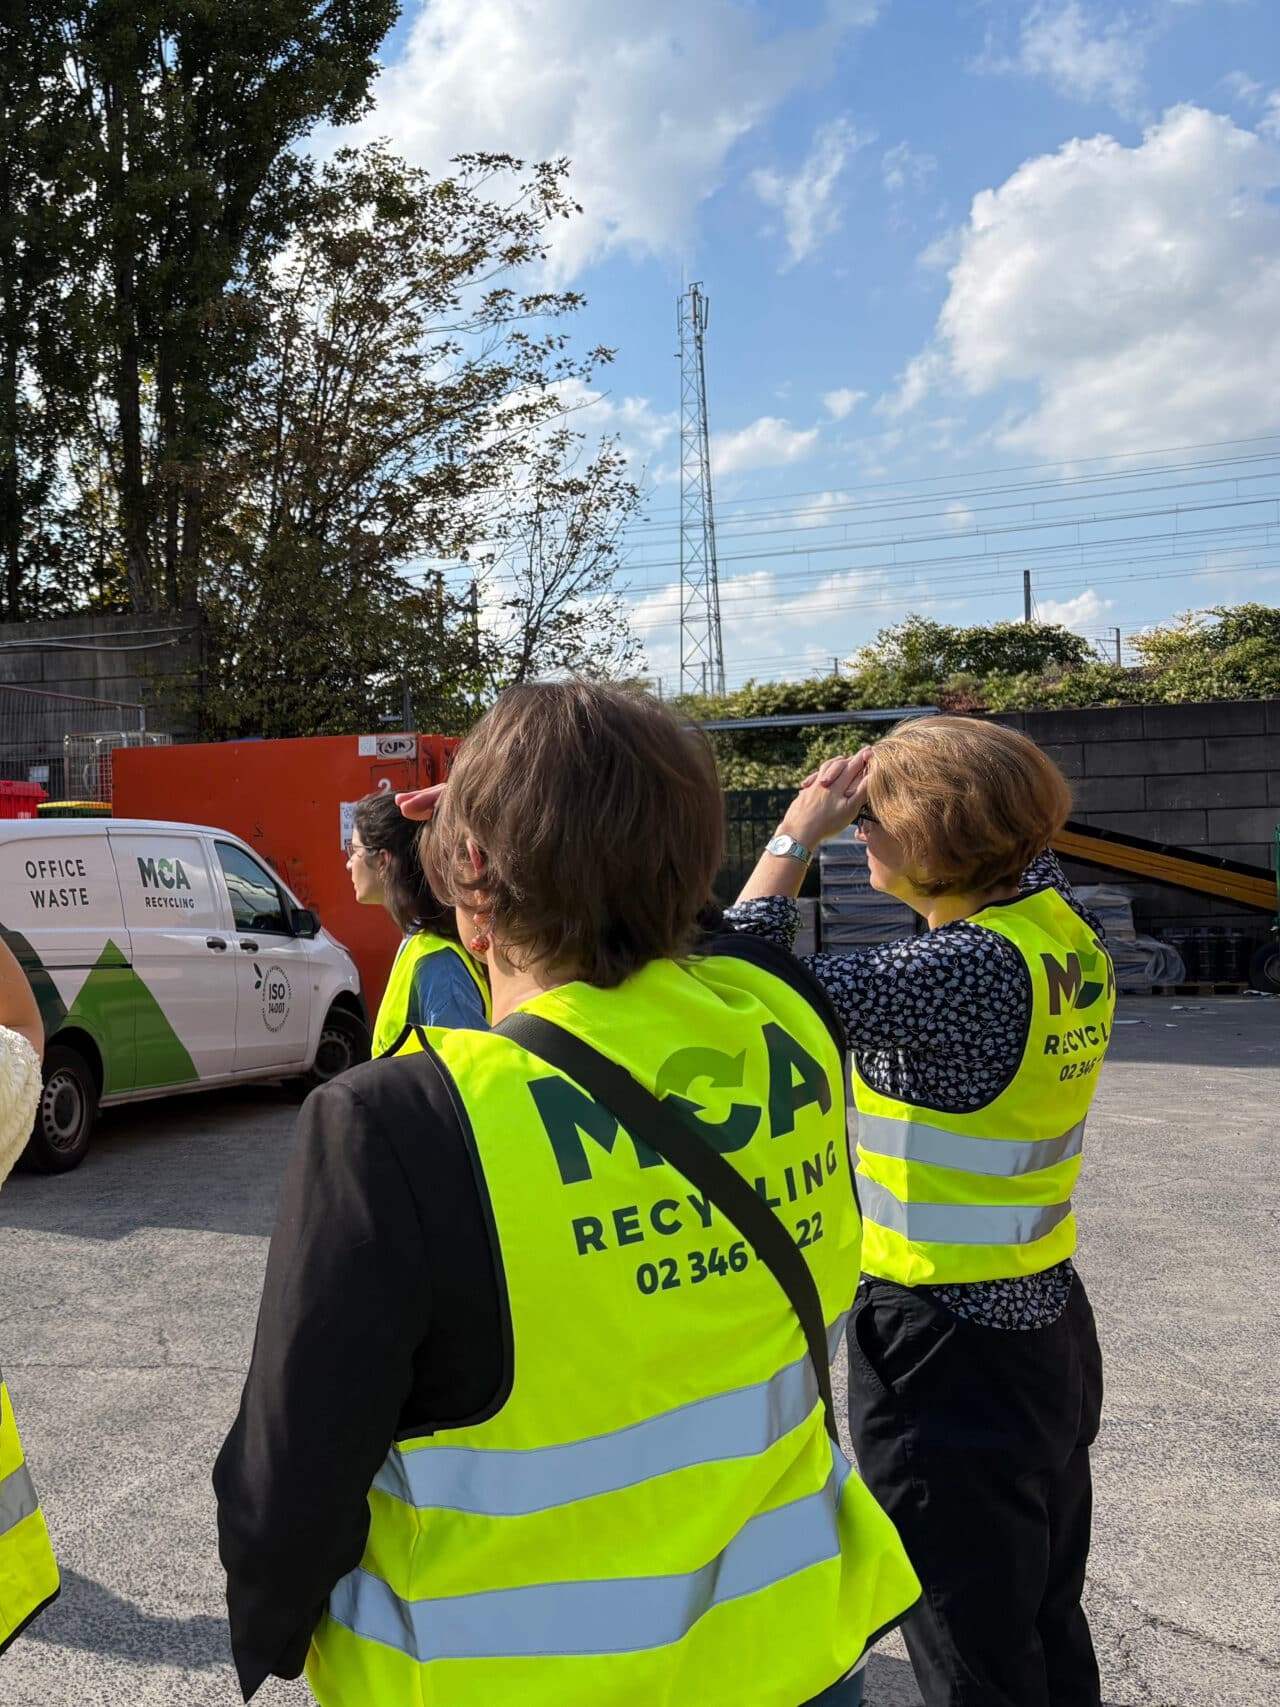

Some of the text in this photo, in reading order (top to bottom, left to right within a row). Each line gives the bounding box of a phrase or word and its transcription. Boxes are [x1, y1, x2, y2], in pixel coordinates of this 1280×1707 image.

[25, 859, 87, 879] OFFICE
[137, 857, 191, 890] MCA
[30, 887, 89, 908] WASTE
[145, 897, 195, 909] RECYCLING
[268, 983, 285, 1000] ISO
[268, 1002, 285, 1014] 14001
[1044, 1022, 1109, 1055] RECYCL
[526, 1021, 832, 1185] MCA
[572, 1140, 837, 1256] RECYLING
[636, 1257, 681, 1295] 02
[687, 1242, 748, 1284] 346
[795, 1211, 823, 1250] 22
